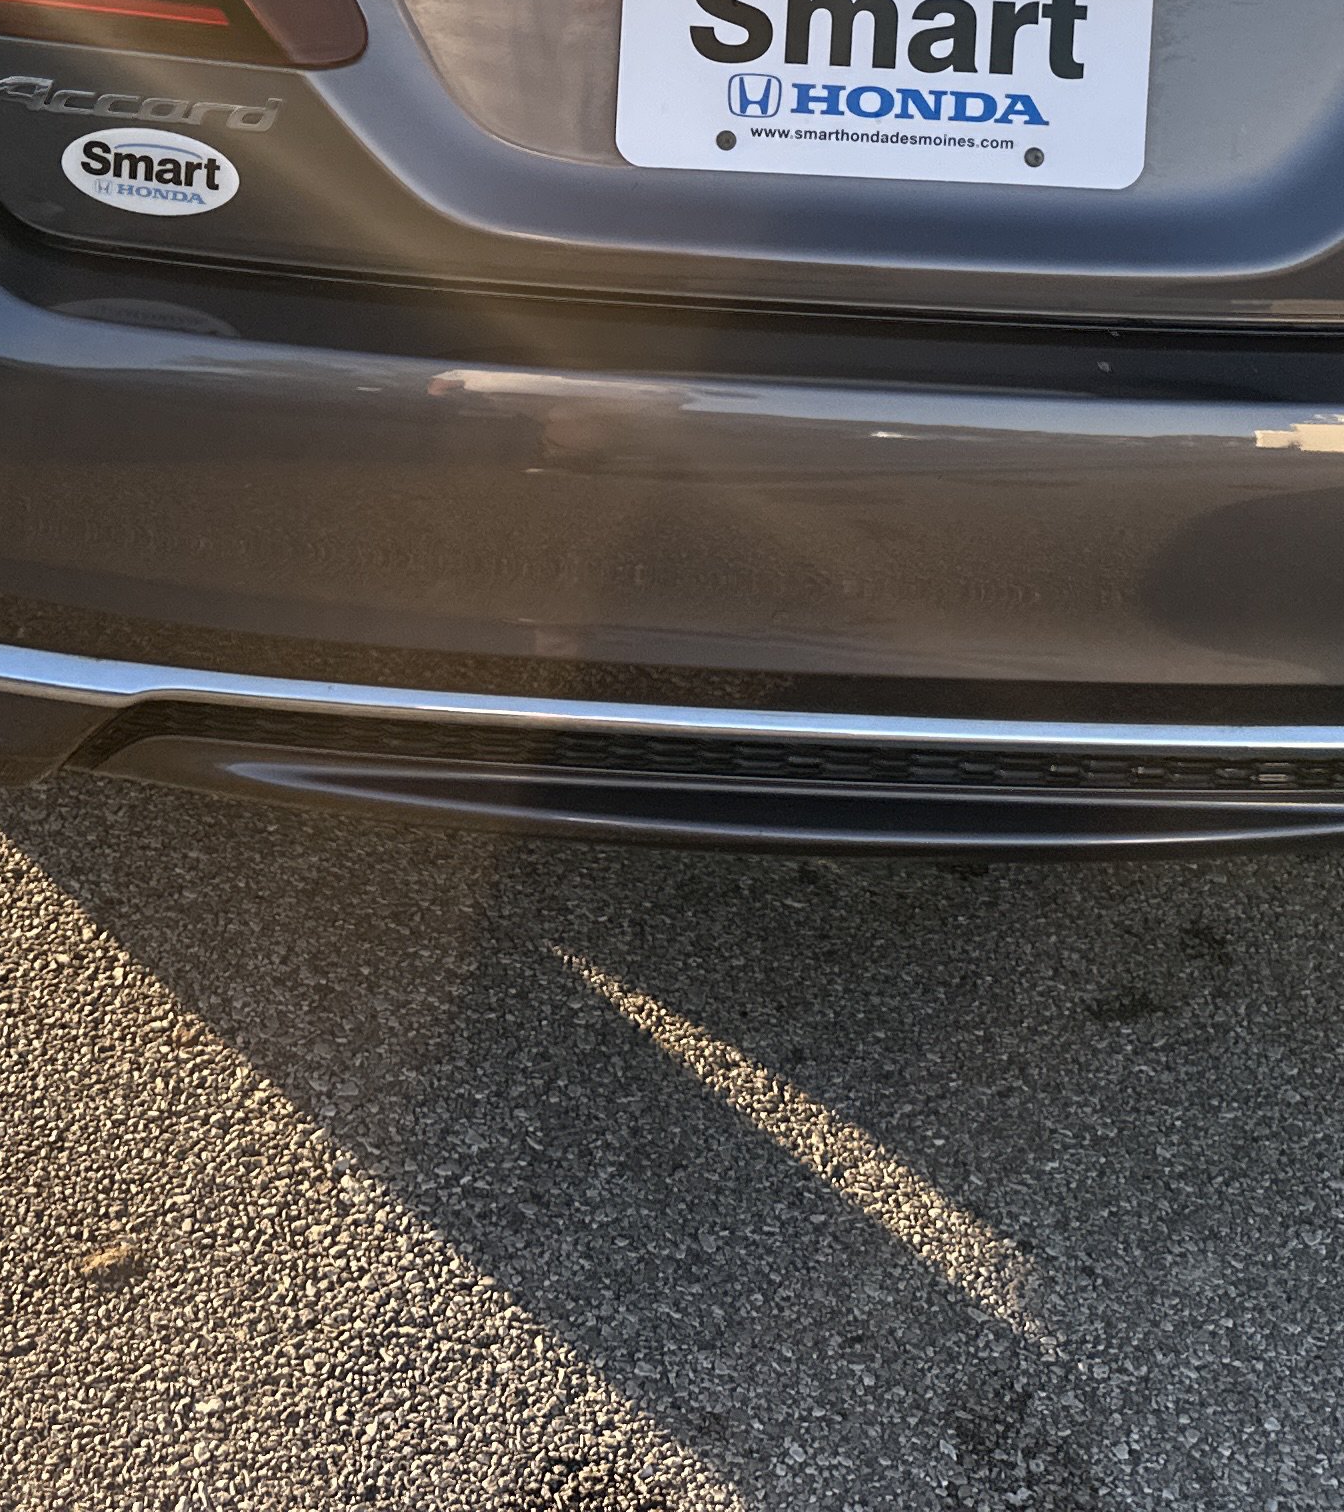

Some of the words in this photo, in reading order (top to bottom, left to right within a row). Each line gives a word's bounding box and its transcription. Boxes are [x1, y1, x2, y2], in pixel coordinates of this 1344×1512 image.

[790, 82, 1050, 125] HONDA
[749, 125, 1015, 151] www.smarthondadesmoines.com
[80, 140, 221, 191] Smart
[117, 183, 207, 205] HONDA
